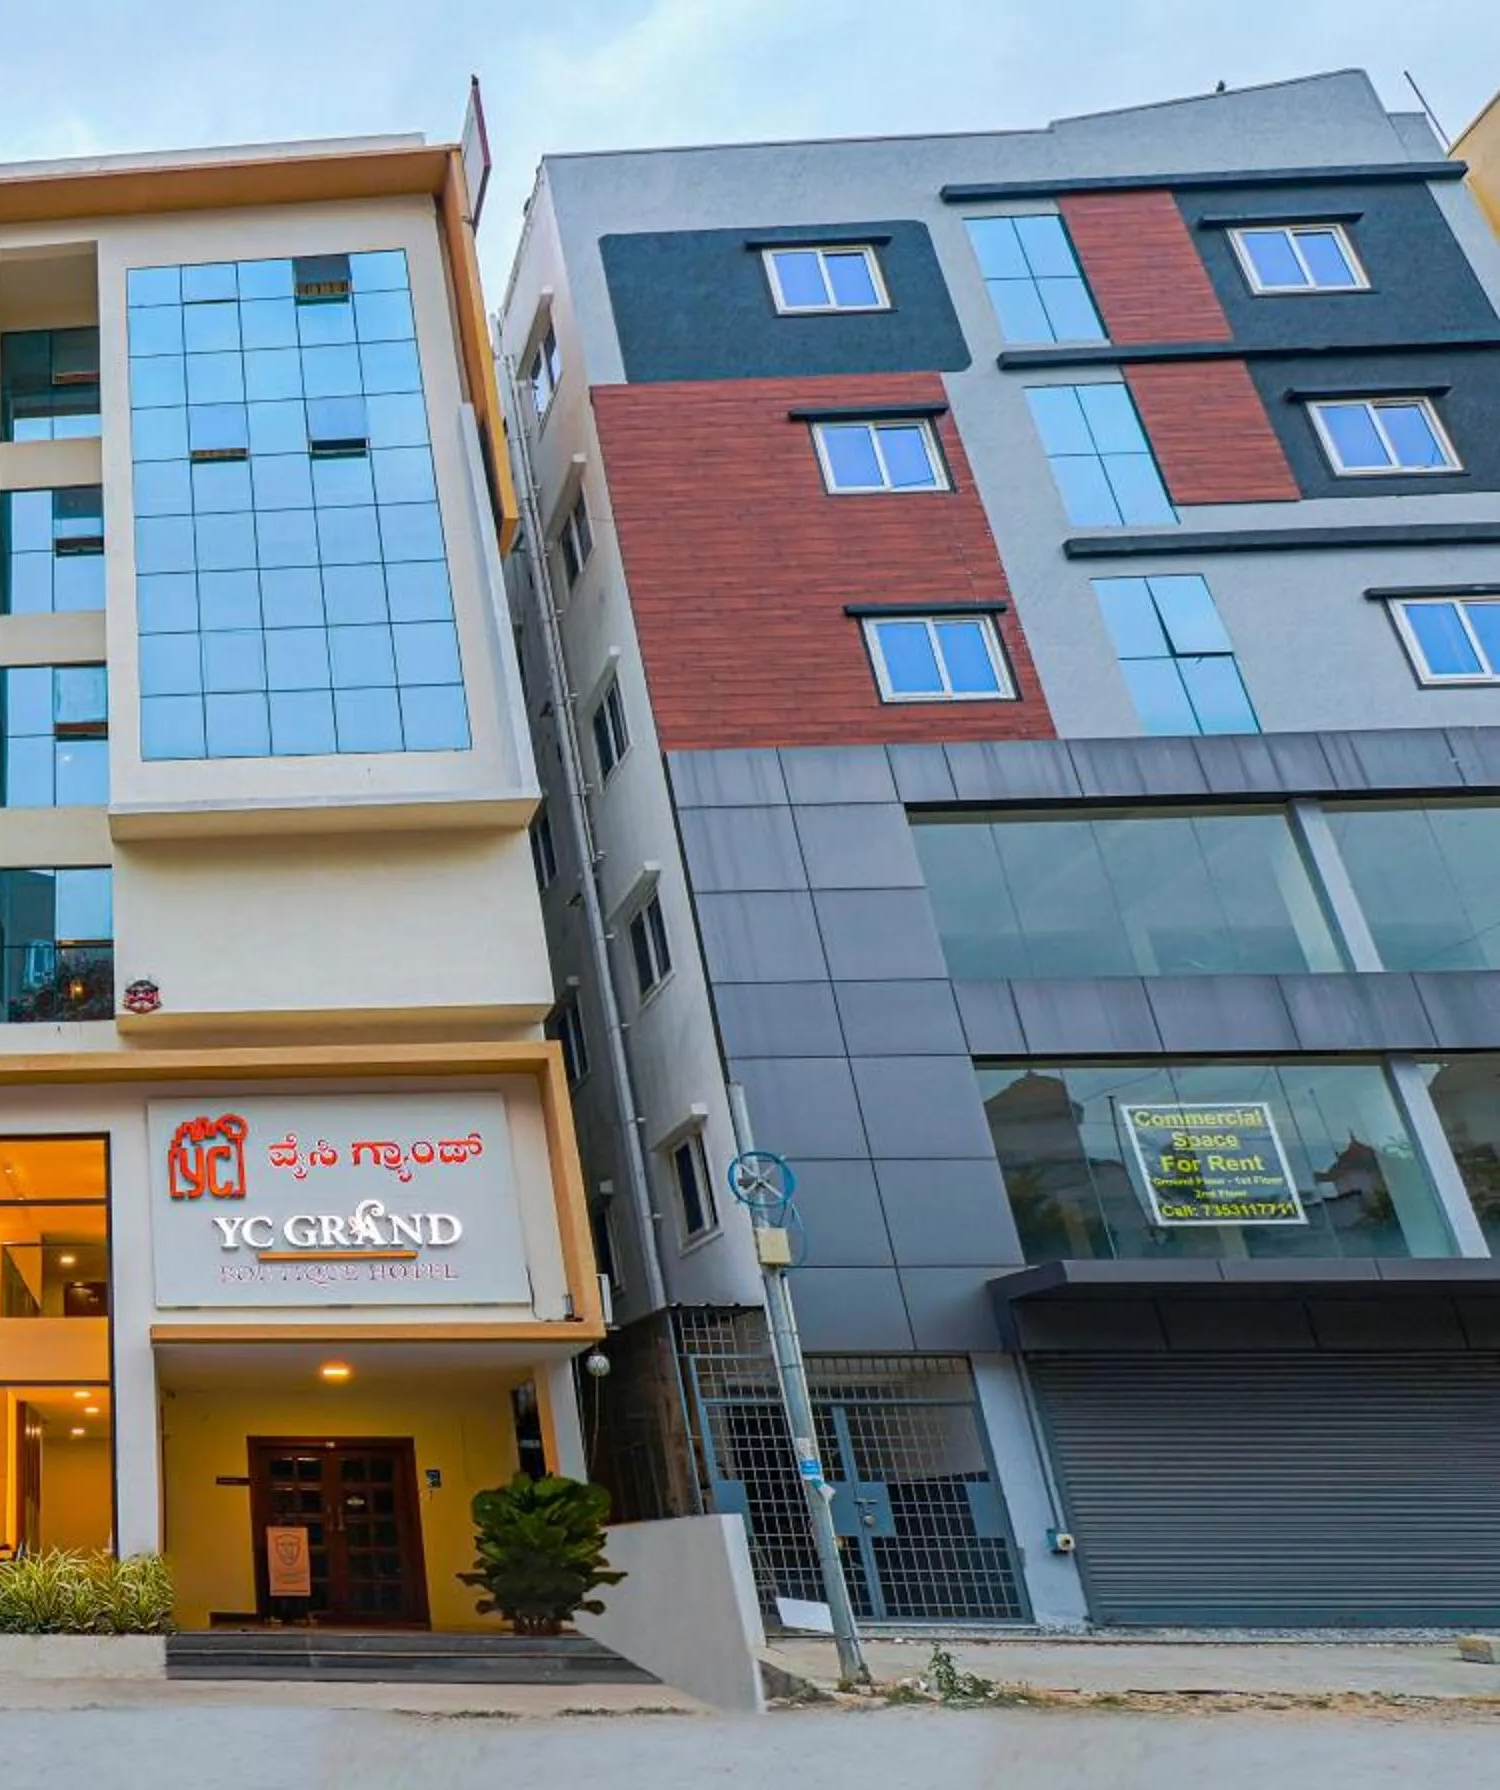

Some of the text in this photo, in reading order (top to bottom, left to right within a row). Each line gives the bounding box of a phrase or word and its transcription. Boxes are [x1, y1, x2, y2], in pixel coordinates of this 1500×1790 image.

[1134, 1109, 1262, 1126] Commercial
[1171, 1131, 1240, 1149] Space
[1160, 1154, 1265, 1172] For Rent
[213, 1199, 463, 1249] YC GRAND
[369, 1263, 460, 1281] HOTEL
